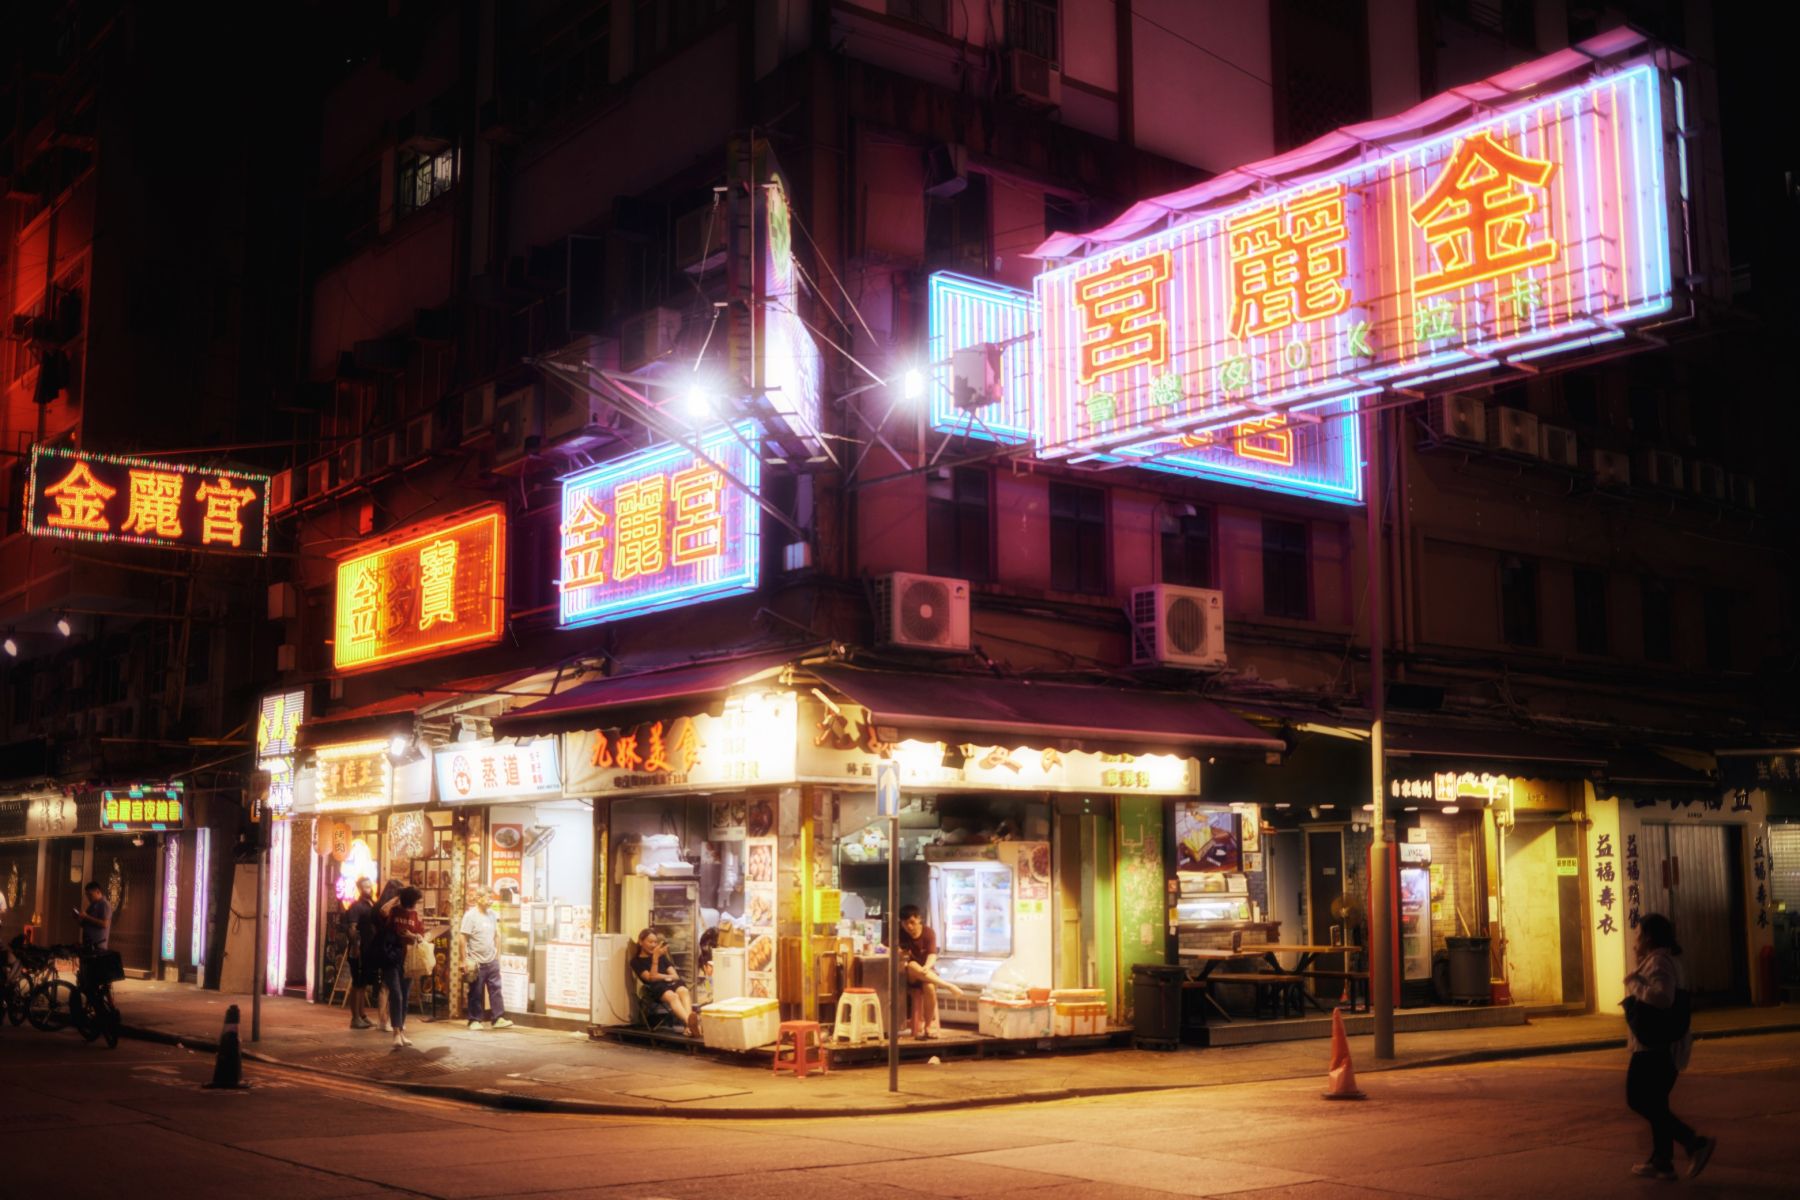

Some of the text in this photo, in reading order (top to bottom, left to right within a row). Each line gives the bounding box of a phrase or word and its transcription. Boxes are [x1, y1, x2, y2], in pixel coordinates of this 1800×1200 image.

[44, 460, 256, 548] 金麗宮
[560, 458, 727, 593] 金麗宮
[481, 754, 520, 788] 蒸道
[1595, 834, 1618, 935] 益福壽衣
